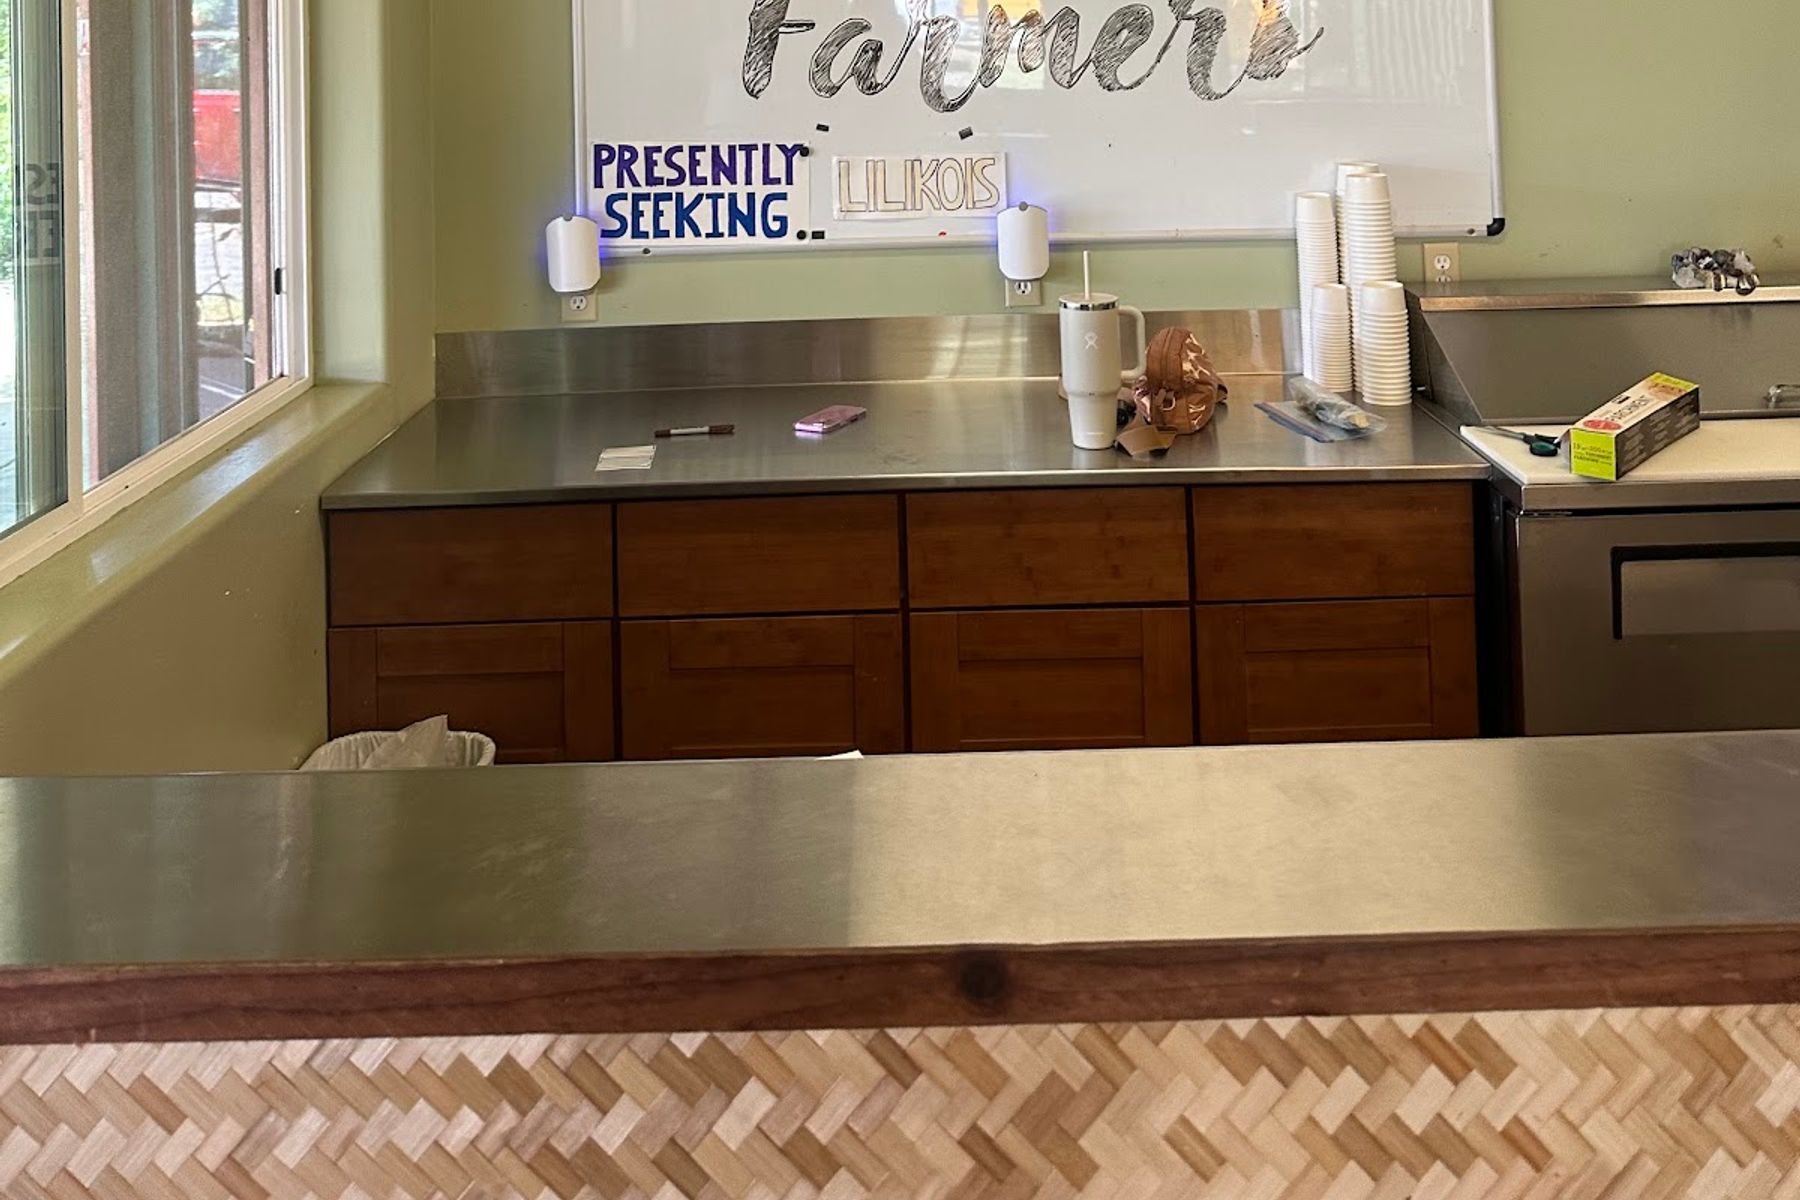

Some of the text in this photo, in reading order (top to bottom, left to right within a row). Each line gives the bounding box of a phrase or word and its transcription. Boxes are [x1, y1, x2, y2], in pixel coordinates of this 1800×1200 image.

[593, 143, 803, 188] PRESENTLY
[838, 157, 1000, 212] LILIKOIS
[600, 191, 789, 240] SEEKING
